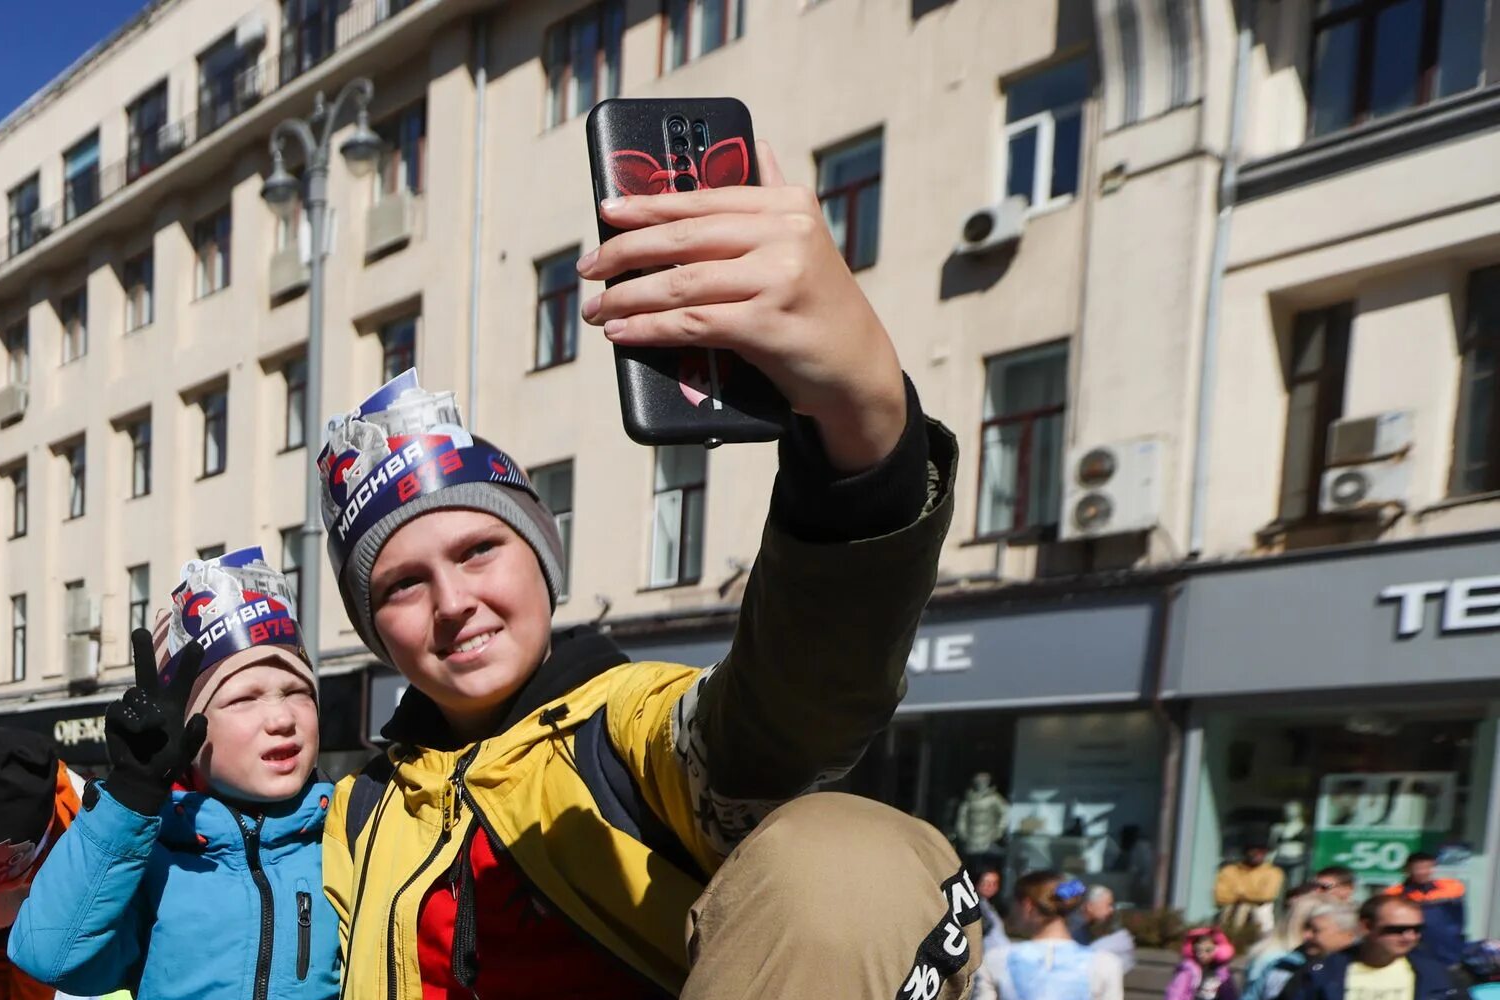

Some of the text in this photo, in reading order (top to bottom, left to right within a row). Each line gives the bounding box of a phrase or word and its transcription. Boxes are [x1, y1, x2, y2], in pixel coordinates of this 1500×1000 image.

[336, 440, 425, 542] МОСКВА
[396, 449, 464, 503] 875
[197, 600, 271, 650] ОСКВА
[249, 617, 295, 644] 875
